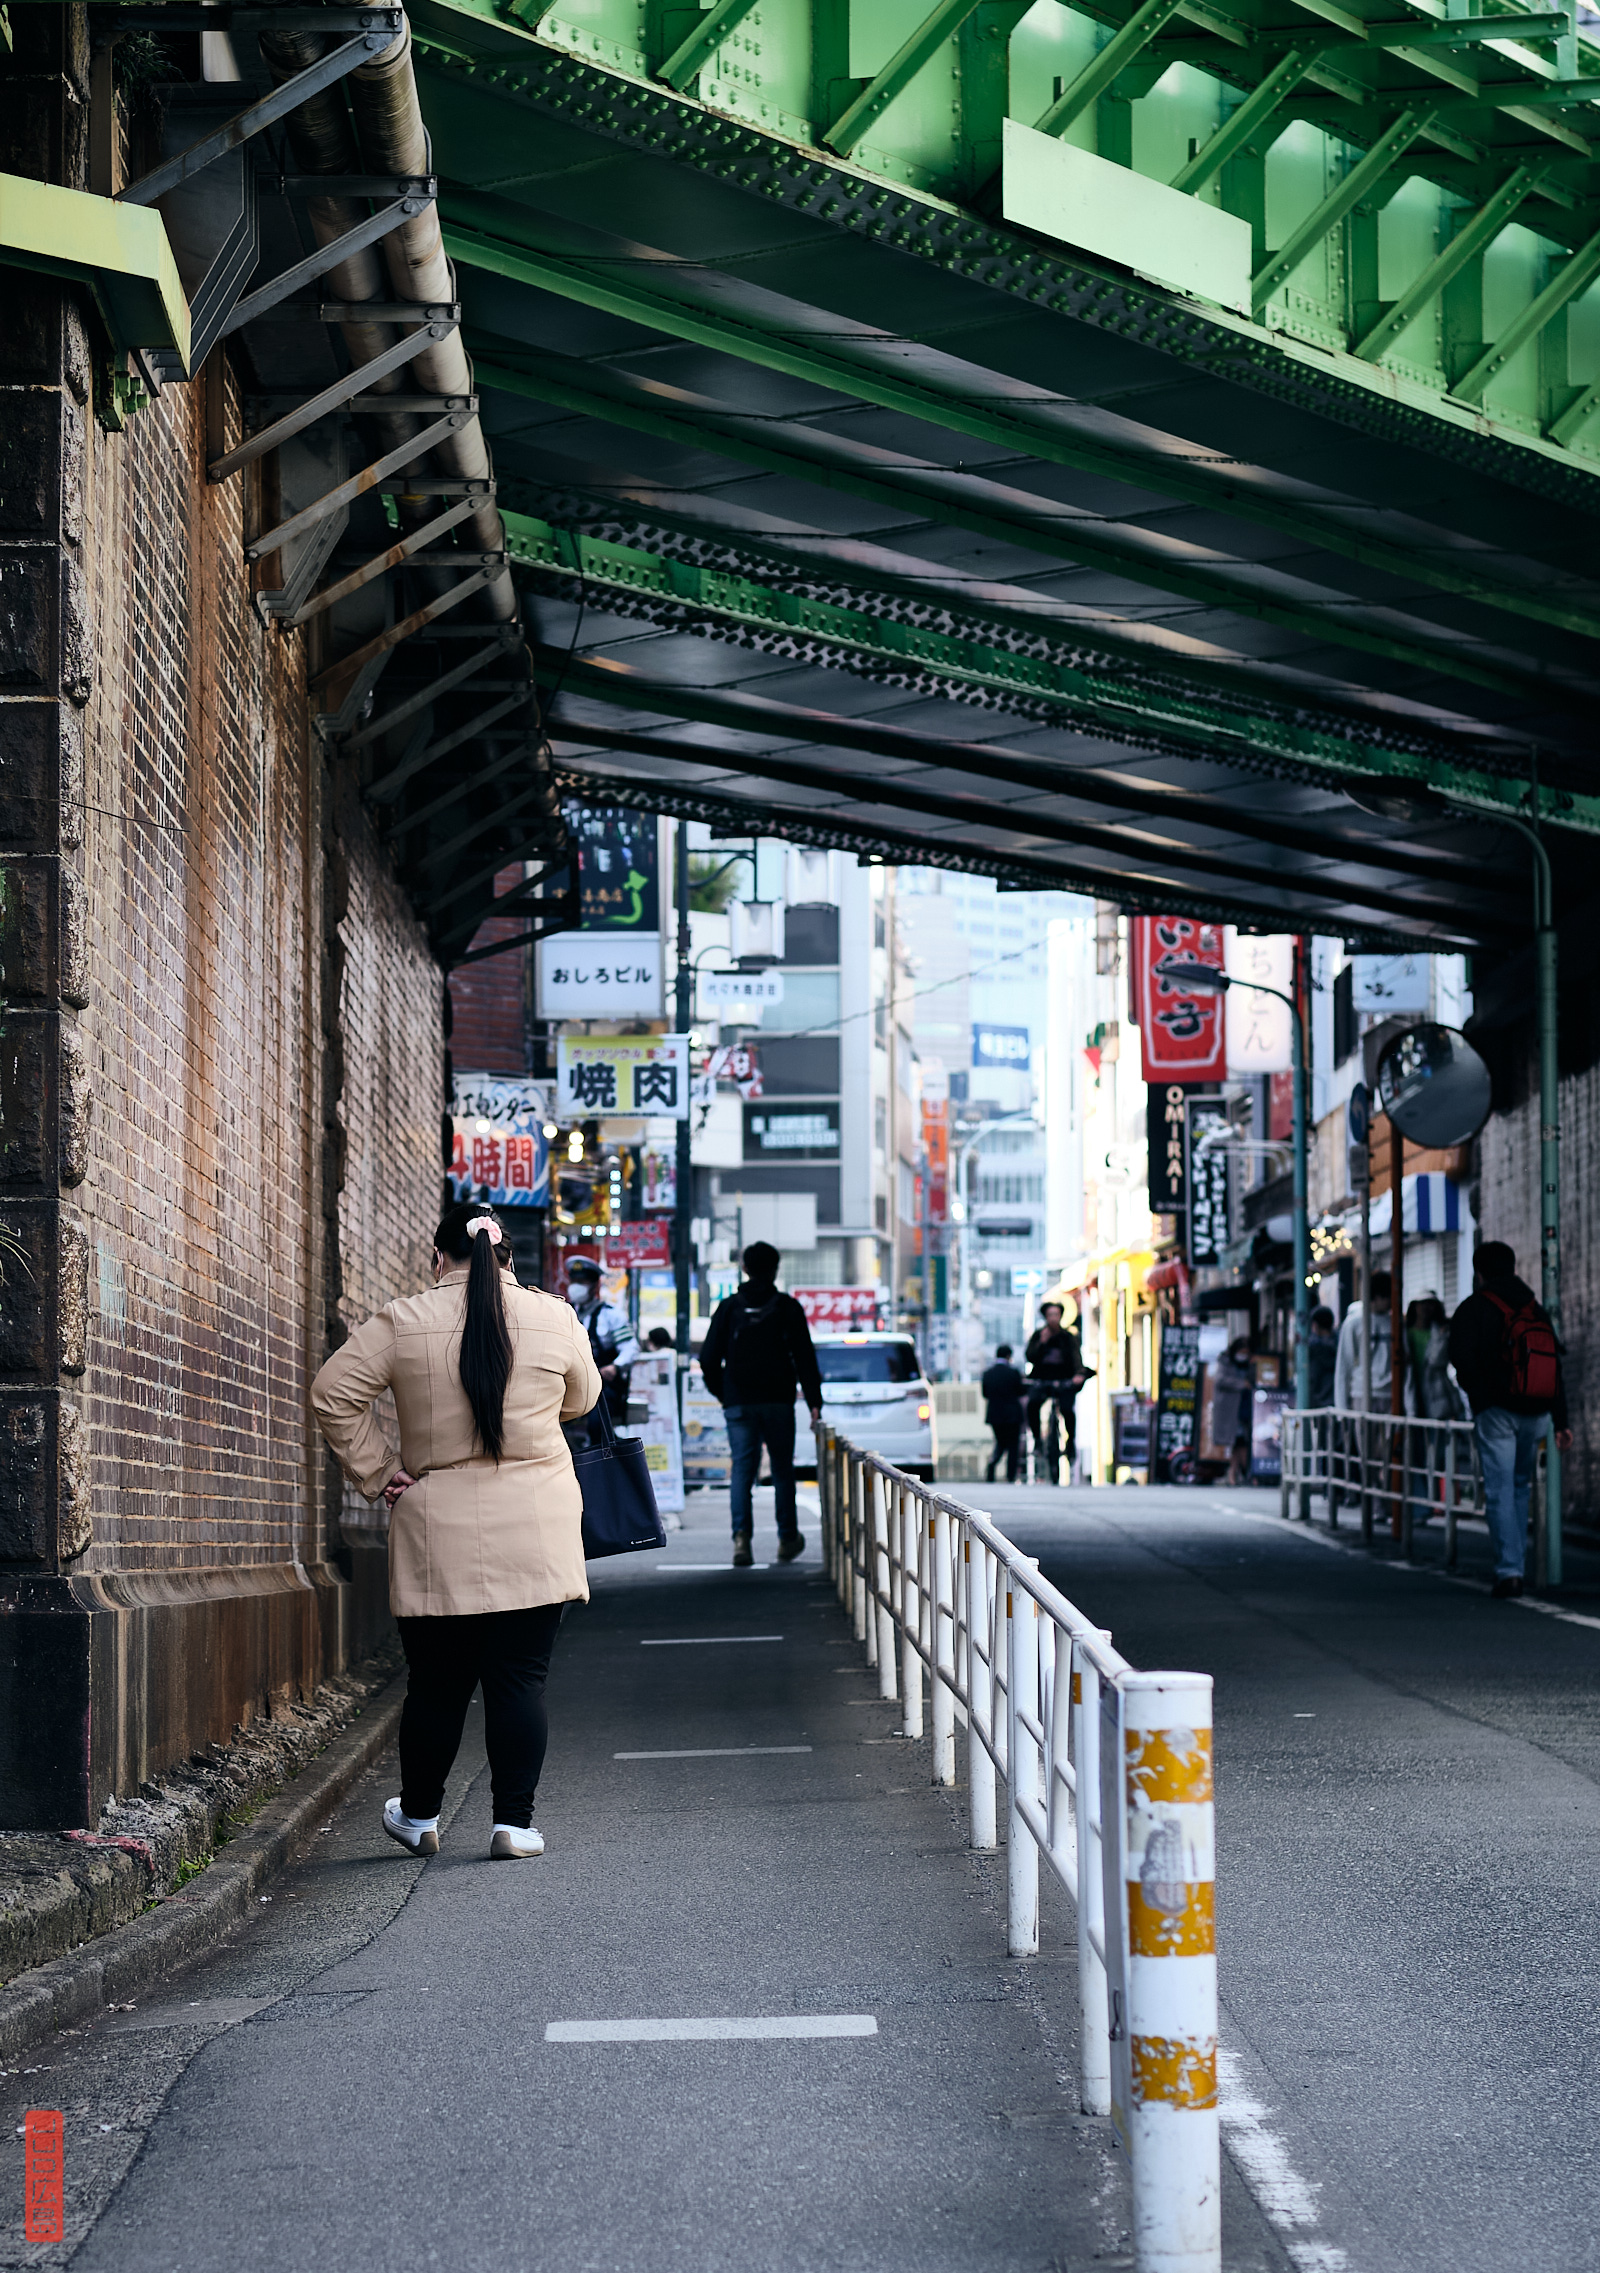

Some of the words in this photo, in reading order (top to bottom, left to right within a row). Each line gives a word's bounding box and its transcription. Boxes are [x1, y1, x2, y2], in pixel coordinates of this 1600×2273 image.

[552, 965, 652, 985] おしろビル
[569, 1061, 678, 1108] 焼肉
[1165, 1085, 1185, 1196] OMIRAI
[797, 1292, 873, 1317] カラオケ
